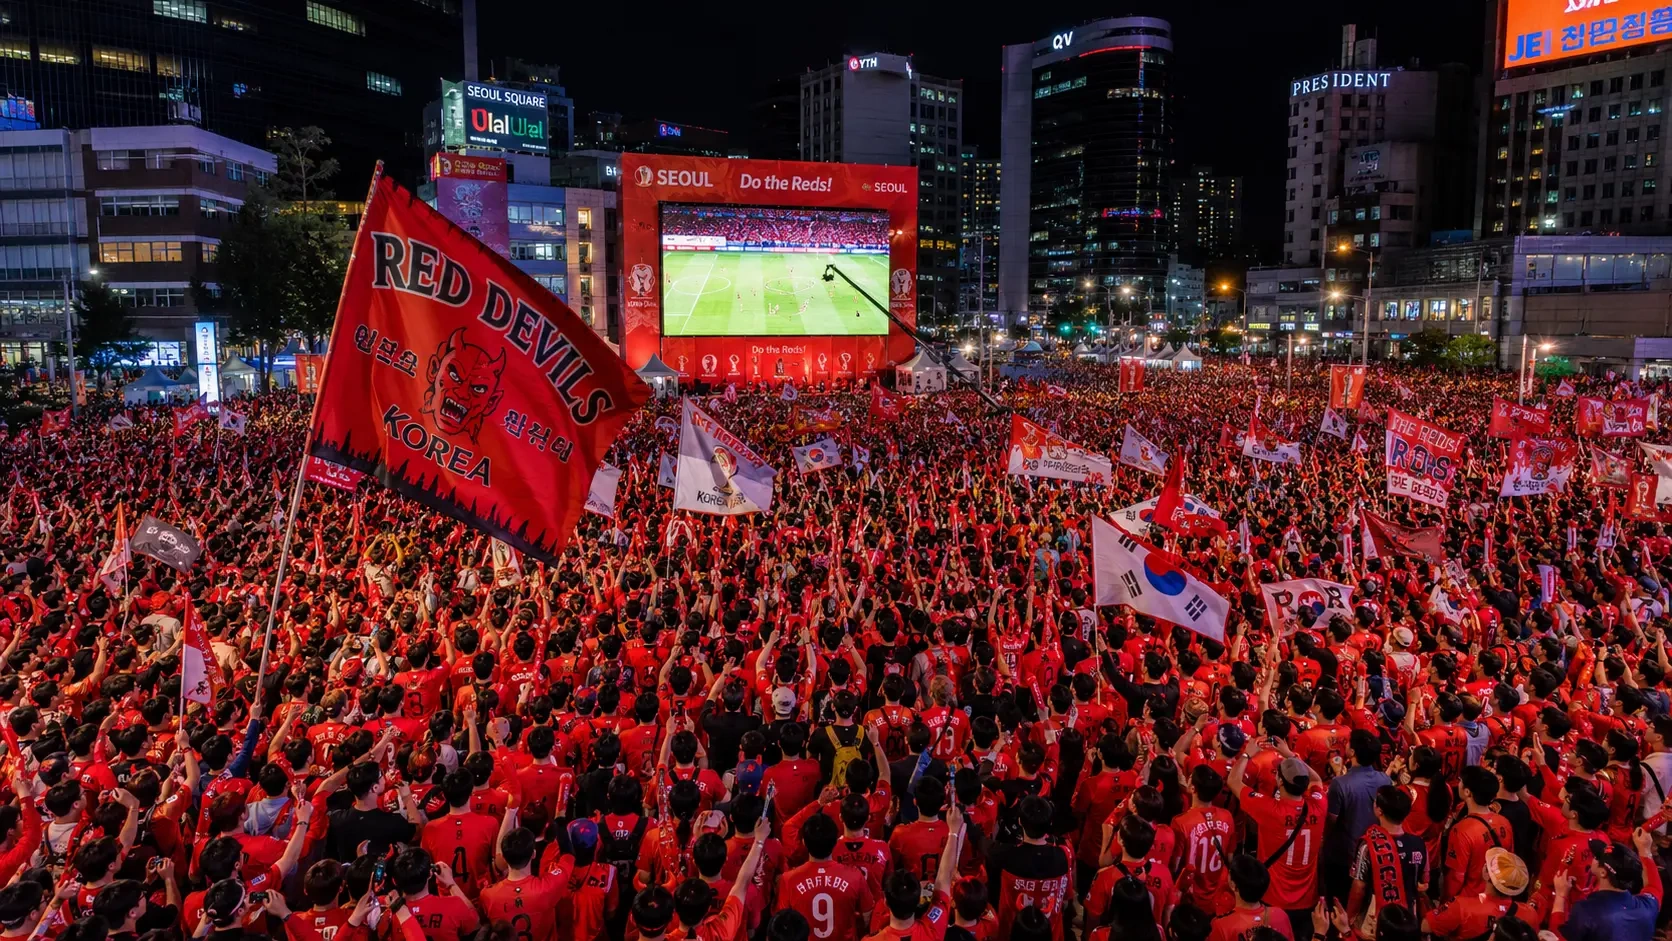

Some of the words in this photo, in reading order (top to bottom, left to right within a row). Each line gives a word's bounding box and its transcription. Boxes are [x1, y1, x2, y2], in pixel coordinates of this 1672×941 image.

[1053, 31, 1073, 49] QV
[467, 85, 502, 101] SEOUL
[504, 91, 545, 108] SQUARE
[657, 170, 713, 188] SEOUL
[740, 173, 755, 189] Do
[764, 175, 788, 190] the
[791, 176, 832, 192] Reds!
[874, 182, 907, 193] SEOUL
[371, 231, 472, 307] RED
[477, 279, 615, 426] DEVILS
[752, 345, 764, 354] Do
[382, 405, 491, 488] KOREA
[1285, 829, 1311, 865] 11
[812, 892, 834, 938] 9
